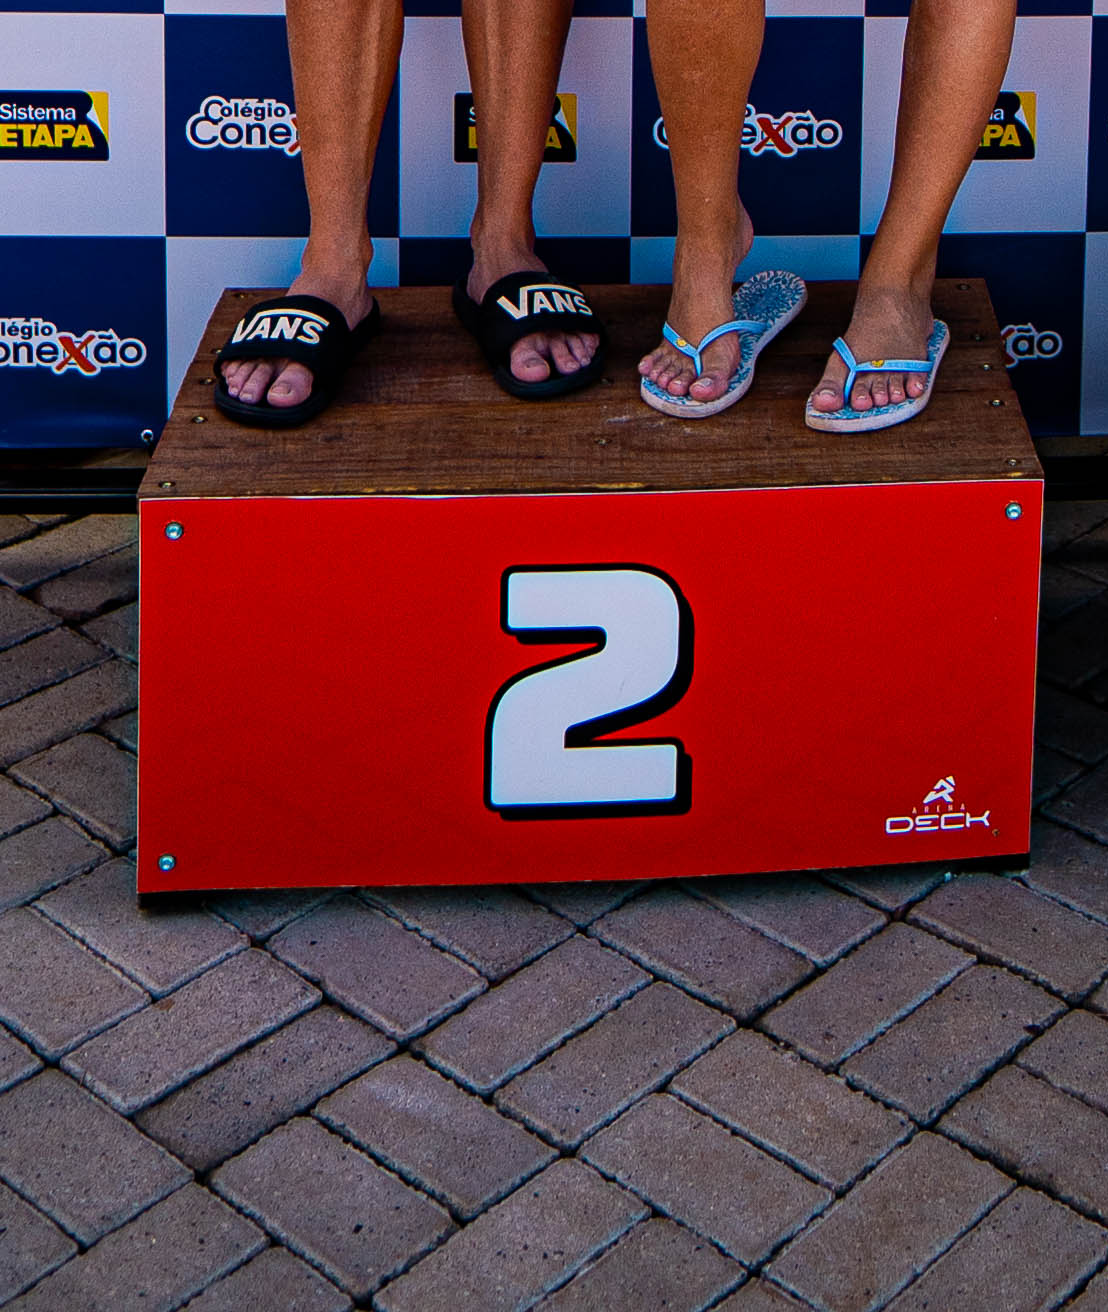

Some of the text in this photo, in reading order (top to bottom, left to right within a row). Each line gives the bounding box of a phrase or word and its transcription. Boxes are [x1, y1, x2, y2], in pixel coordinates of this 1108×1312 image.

[0, 104, 76, 121] Sistema
[206, 98, 287, 121] Colégio
[0, 124, 94, 148] ETAPA
[497, 284, 592, 319] VANS
[1, 320, 53, 338] légio
[232, 309, 329, 344] VANS
[487, 566, 686, 814] 2
[885, 810, 990, 834] DECK
